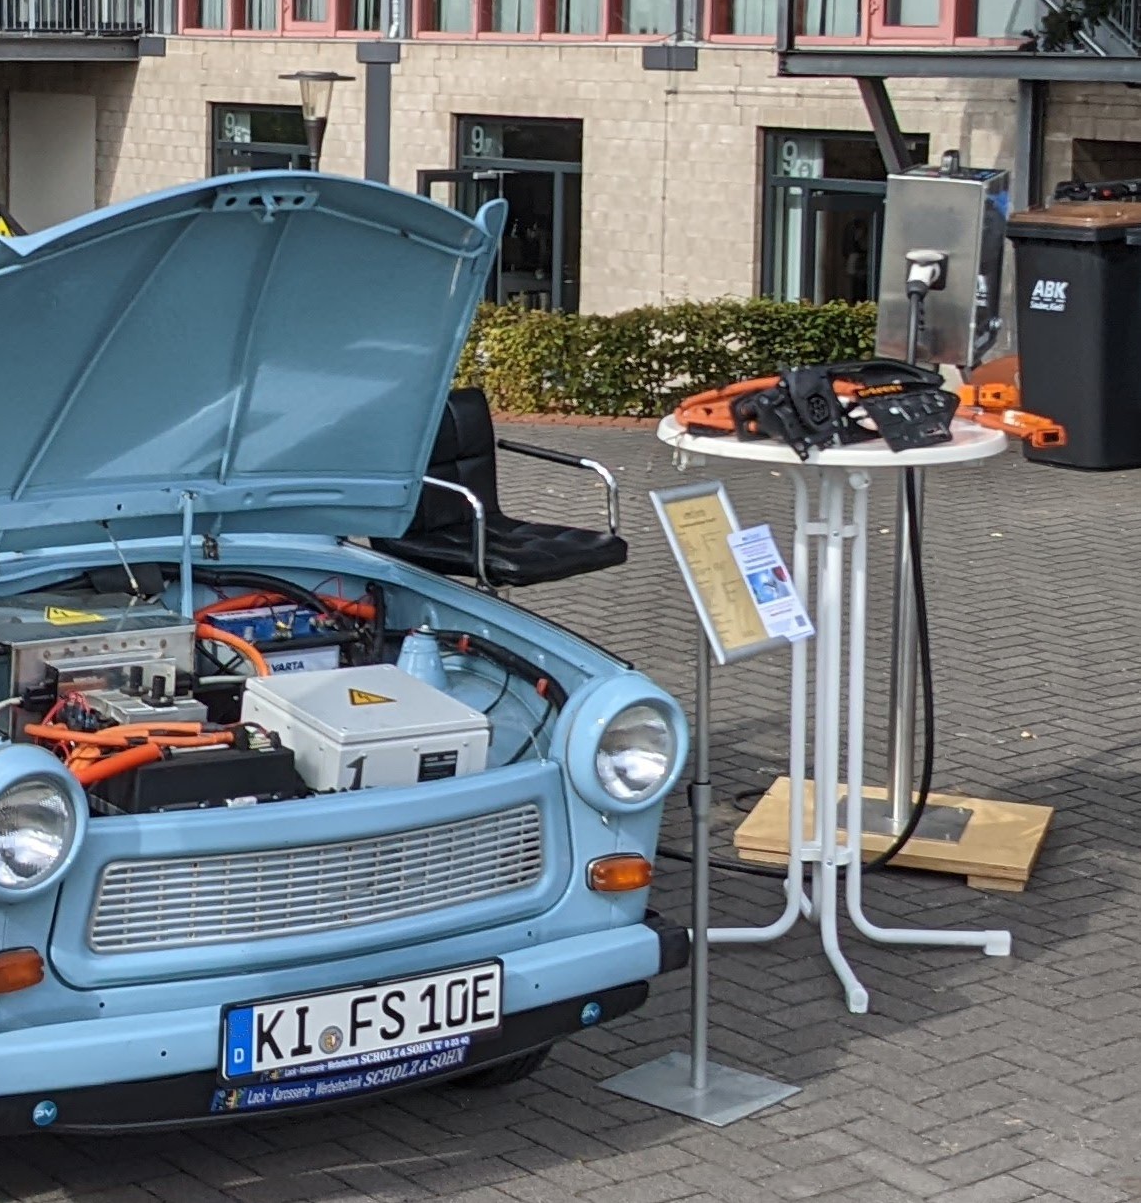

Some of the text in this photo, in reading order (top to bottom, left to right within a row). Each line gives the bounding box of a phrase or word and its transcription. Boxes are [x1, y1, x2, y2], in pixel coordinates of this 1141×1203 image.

[225, 113, 236, 138] 9
[471, 125, 484, 153] 9
[783, 141, 797, 172] 9
[1032, 280, 1069, 299] ABK
[271, 660, 305, 672] VARTA
[255, 972, 496, 1063] KI FS 10E
[233, 1047, 244, 1064] D
[360, 1048, 400, 1065] SCHOLZ
[406, 1042, 433, 1058] SOHN
[246, 1089, 267, 1104] Lack
[271, 1083, 310, 1102] Karosserie
[363, 1059, 419, 1087] SCHOLZ
[427, 1046, 466, 1070] SOHN
